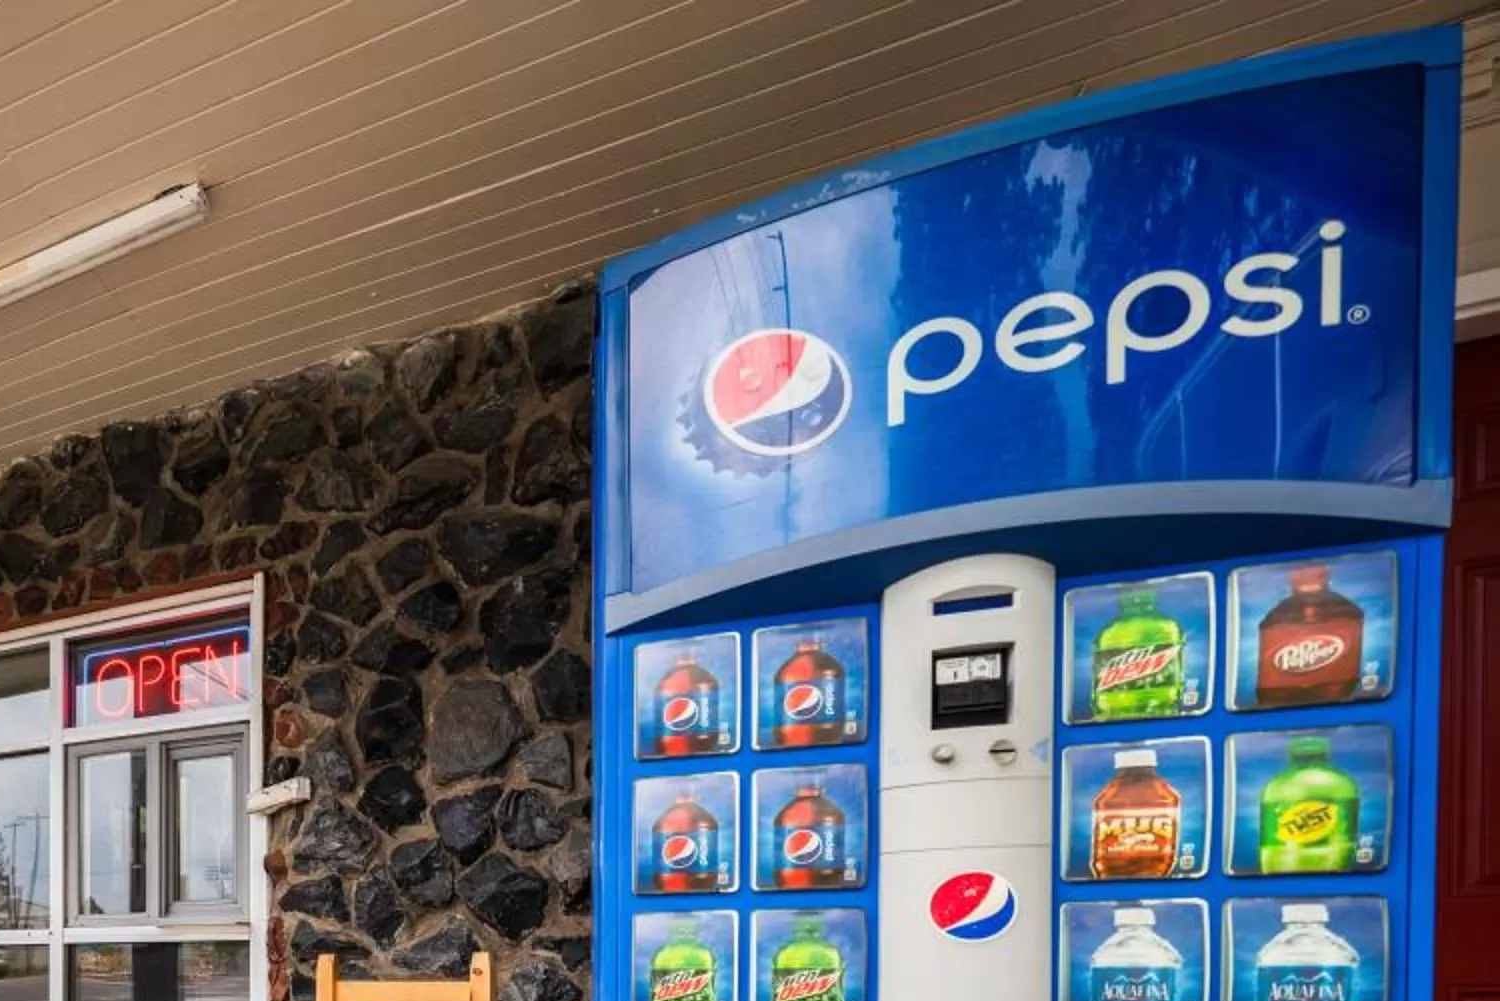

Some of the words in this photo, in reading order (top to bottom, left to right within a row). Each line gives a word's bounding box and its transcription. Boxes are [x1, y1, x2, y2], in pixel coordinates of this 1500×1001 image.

[887, 219, 1346, 427] pepsi
[97, 640, 240, 718] OPEN
[1099, 816, 1173, 840] MUG
[1102, 981, 1170, 1001] AQUAFINA
